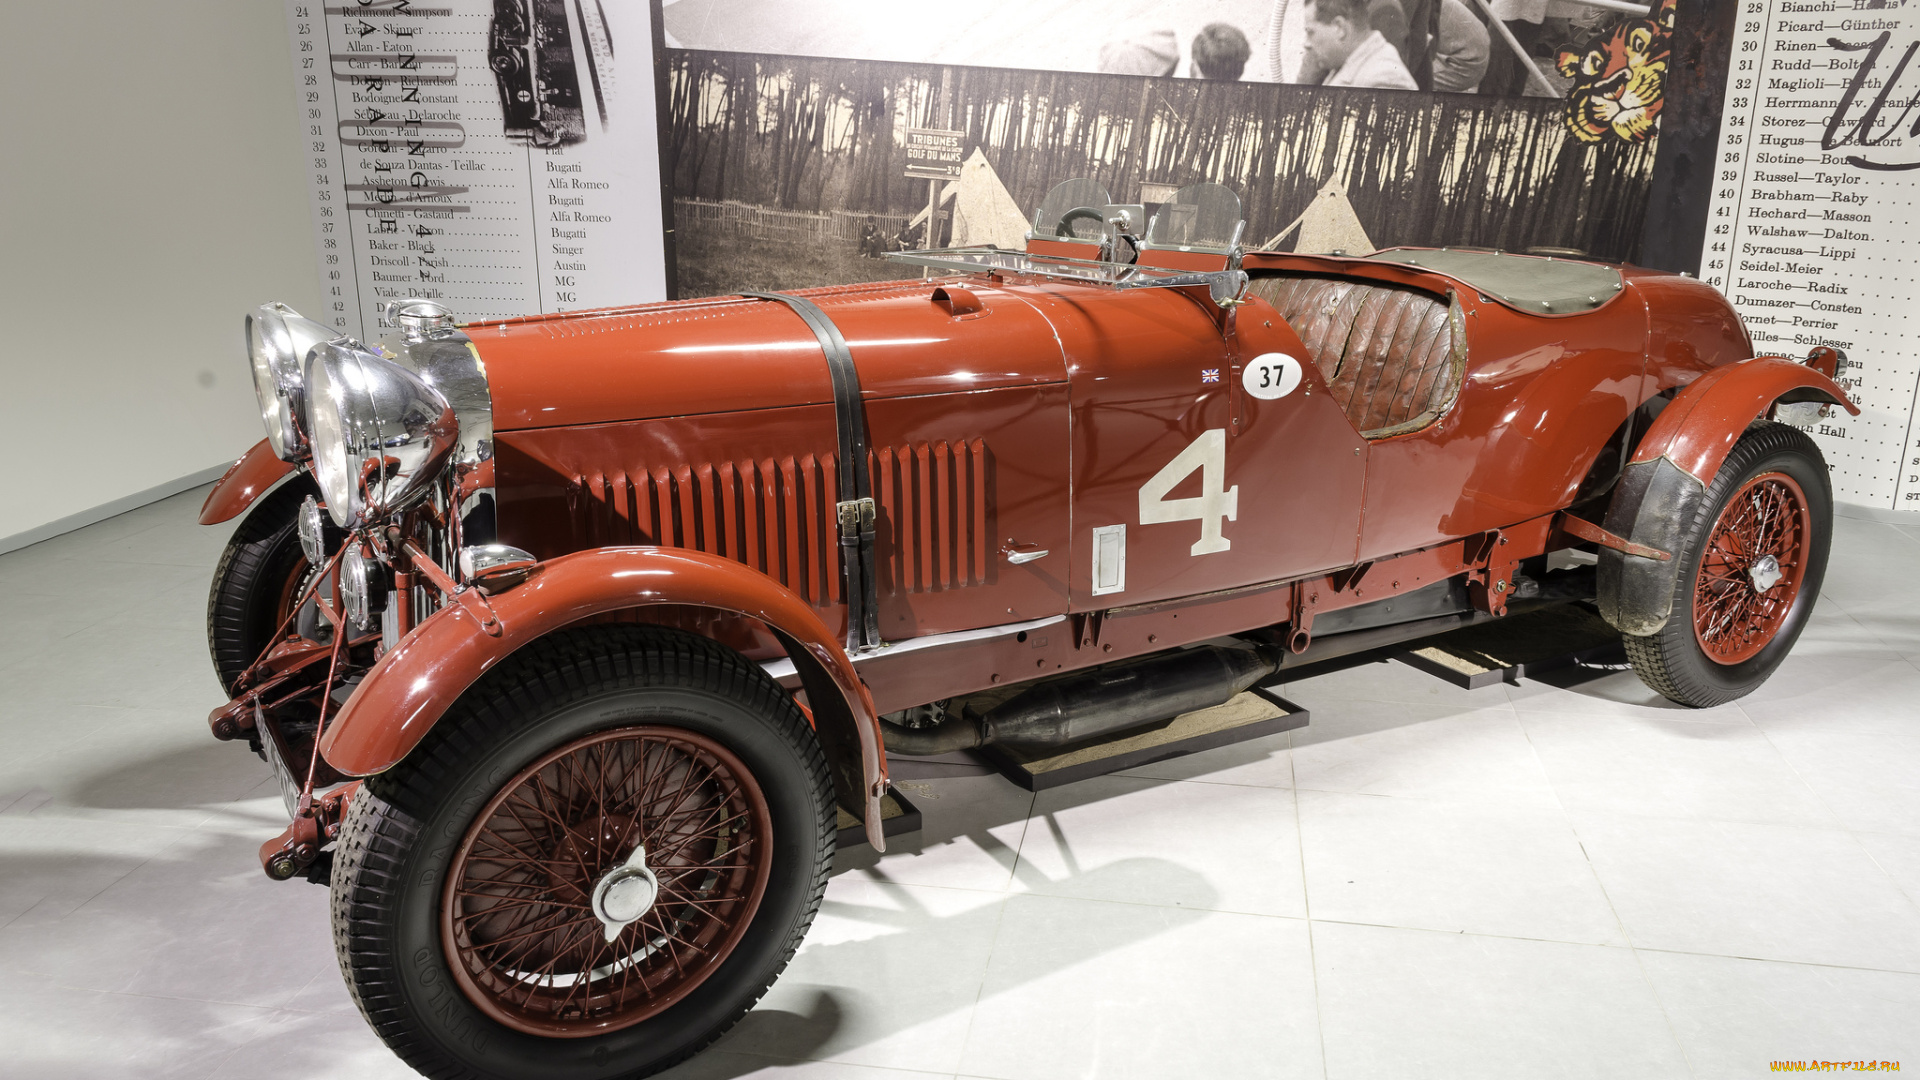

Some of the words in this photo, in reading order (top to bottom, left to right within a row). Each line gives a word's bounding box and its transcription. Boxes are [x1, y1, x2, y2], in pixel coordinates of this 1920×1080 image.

[295, 6, 309, 18] 24
[342, 5, 396, 18] Richmond
[405, 5, 450, 19] Simpson
[1747, 2, 1763, 13] 28
[297, 23, 311, 35] 25
[383, 23, 424, 35] Skinner
[1744, 21, 1760, 33] 29
[299, 40, 313, 52] 26
[346, 40, 374, 53] Allan
[382, 40, 413, 53] Eaton
[1741, 40, 1758, 52] 30
[302, 57, 314, 69] 27
[348, 57, 372, 70] Carr
[380, 57, 423, 70] Barur
[1738, 59, 1753, 71] 31
[1771, 58, 1877, 71] Rudd—Boltn
[304, 74, 318, 86] 28
[350, 74, 392, 87] Doon
[400, 75, 458, 87] Richardson
[1735, 78, 1752, 90] 32
[1768, 77, 1882, 93] Maglioli—Brth
[306, 91, 319, 103] 29
[413, 92, 459, 104] Constant
[1732, 96, 1749, 109] 33
[308, 108, 322, 120] 30
[408, 108, 461, 121] Delaroche
[1729, 115, 1746, 127] 34
[1761, 115, 1887, 128] Storez—Cawrd
[310, 124, 323, 137] 31
[356, 124, 388, 137] Dixon
[396, 125, 420, 137] Paul
[312, 141, 326, 153] 32
[358, 141, 398, 154] Gorni
[911, 134, 958, 147] TRIBUNES
[1727, 134, 1743, 146] 35
[364, 75, 397, 233] RAPIDE
[907, 148, 926, 159] GOLF
[926, 150, 938, 161] DU
[939, 152, 961, 163] MANS
[1724, 152, 1740, 164] 36
[314, 157, 328, 169] 33
[360, 158, 373, 170] de
[374, 158, 405, 170] Souza
[407, 158, 443, 171] Dantas
[450, 159, 487, 172] Teillac
[546, 160, 582, 175] Bugatti
[316, 173, 329, 185] 34
[362, 174, 408, 187] Assheton
[547, 177, 569, 190] Alfa
[571, 178, 610, 190] Romeo
[1721, 170, 1738, 182] 39
[1753, 170, 1861, 187] Russel—Taylor
[318, 190, 331, 202] 35
[548, 194, 585, 208] Bugatti
[1718, 188, 1735, 199] 40
[1750, 188, 1869, 207] Brabham—Raby
[320, 206, 333, 218] 36
[365, 206, 405, 219] Chinetti
[413, 207, 454, 220] Gastaud
[549, 211, 571, 223] Alfa
[573, 211, 612, 223] Romeo
[1716, 206, 1731, 217] 41
[1747, 206, 1872, 223] Hechard—Masson
[322, 222, 334, 234] 37
[407, 224, 445, 236] Veron
[550, 226, 587, 241] Bugatti
[1713, 224, 1730, 235] 42
[324, 238, 337, 250] 38
[369, 238, 400, 251] Baker
[407, 240, 436, 252] Black
[552, 243, 585, 257] Singer
[1711, 241, 1727, 252] 44
[1742, 242, 1857, 262] Syracusa—Lippi
[326, 254, 339, 266] 39
[370, 254, 410, 267] Driscoll
[553, 259, 587, 271] Austin
[1708, 259, 1724, 270] 45
[1739, 260, 1824, 276] Seidel-Meier
[328, 270, 341, 281] 40
[372, 270, 413, 283] Baumer
[555, 275, 577, 287] MG
[1706, 276, 1722, 287] 46
[1737, 277, 1849, 295] Laroche—Radix
[330, 285, 342, 297] 41
[374, 286, 400, 298] Viale
[556, 291, 578, 303] MG
[332, 300, 345, 312] 42
[1734, 294, 1863, 315] Dumazer—Consten
[334, 316, 346, 328] 43
[1260, 364, 1285, 389] 37
[1818, 423, 1846, 439] Hall
[1138, 428, 1239, 557] 4
[418, 765, 507, 889] RACING
[413, 947, 489, 1056] DUNLOP
